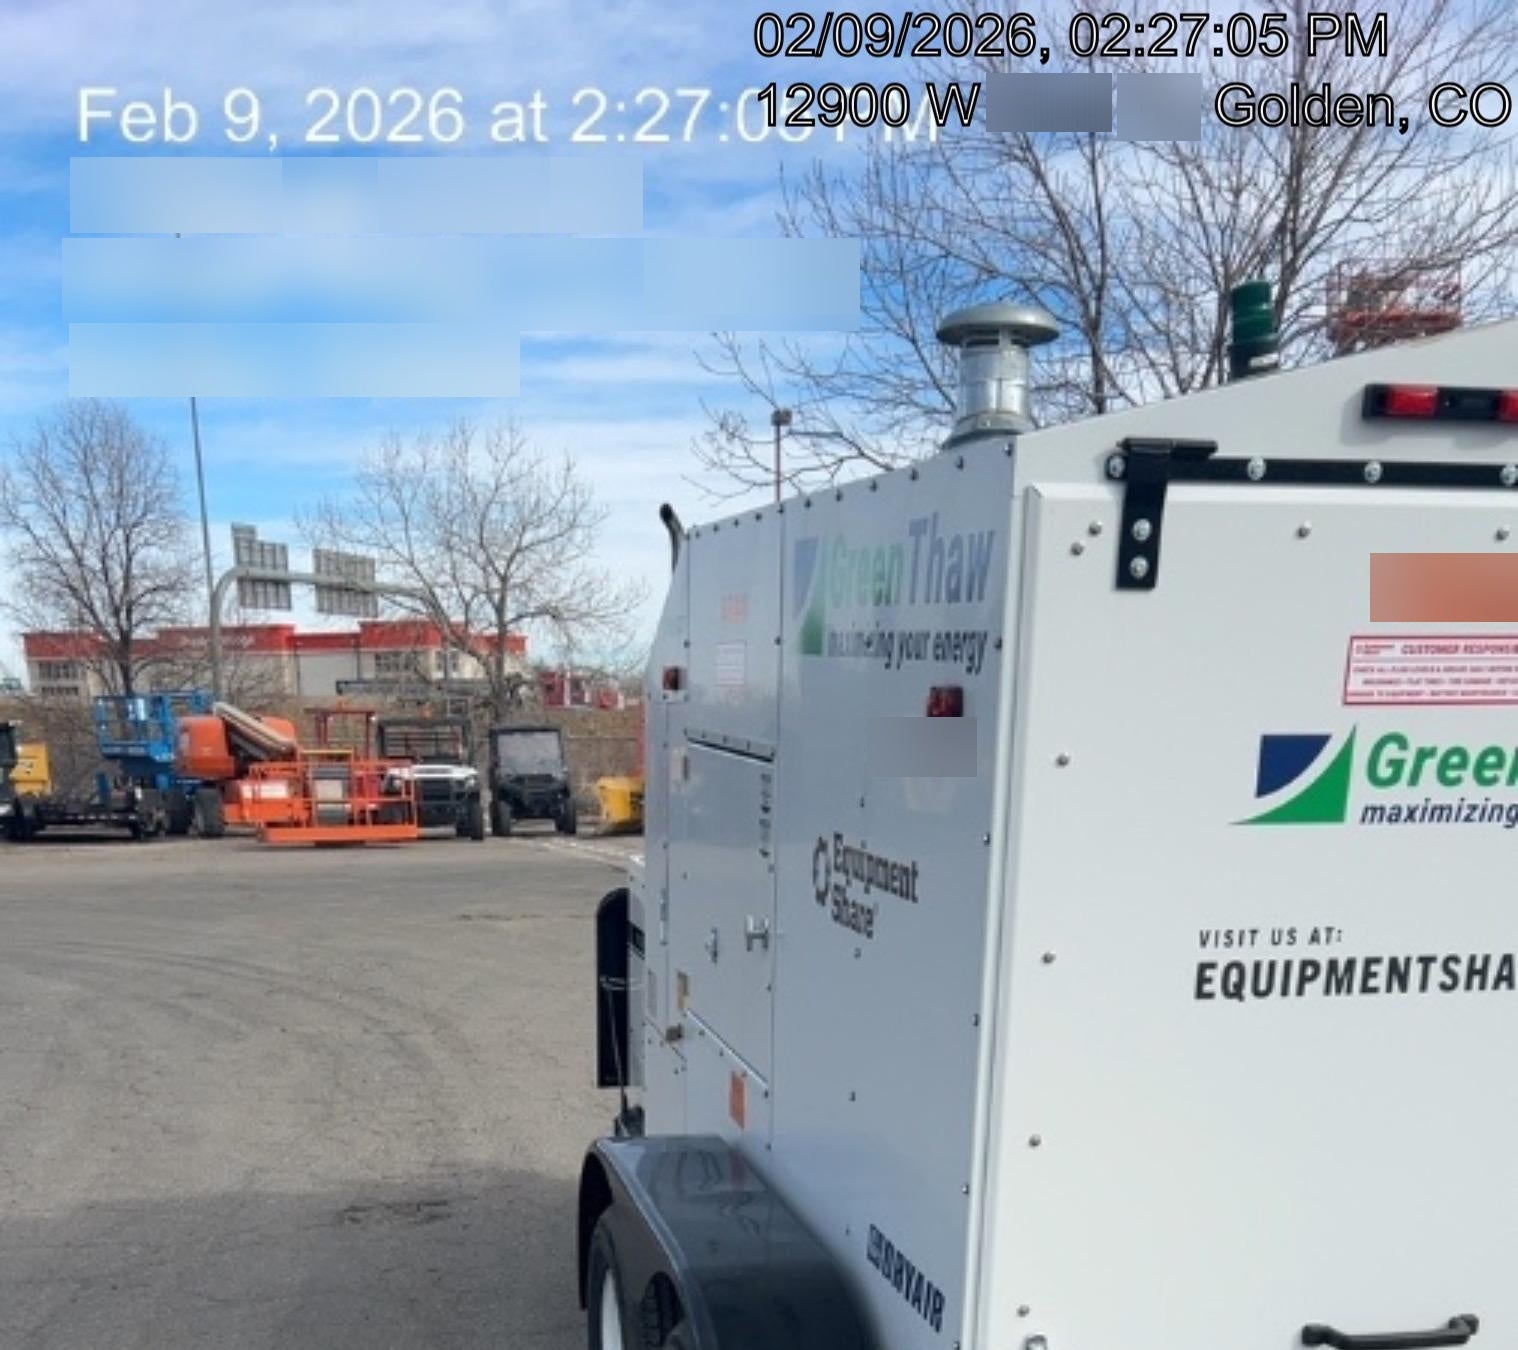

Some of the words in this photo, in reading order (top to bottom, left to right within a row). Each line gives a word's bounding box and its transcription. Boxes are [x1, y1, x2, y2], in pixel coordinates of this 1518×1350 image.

[827, 620, 894, 670] miming
[896, 631, 931, 671] your
[933, 631, 988, 676] energy
[1360, 797, 1518, 829] maximizing
[833, 831, 919, 904] Equipment
[832, 883, 874, 939] Share
[1199, 929, 1259, 949] VISIT
[1270, 927, 1297, 946] US
[1308, 926, 1343, 946] AT:
[1195, 953, 1517, 1002] EQUIPMENTSHA
[881, 1238, 946, 1334] DRYAIR
